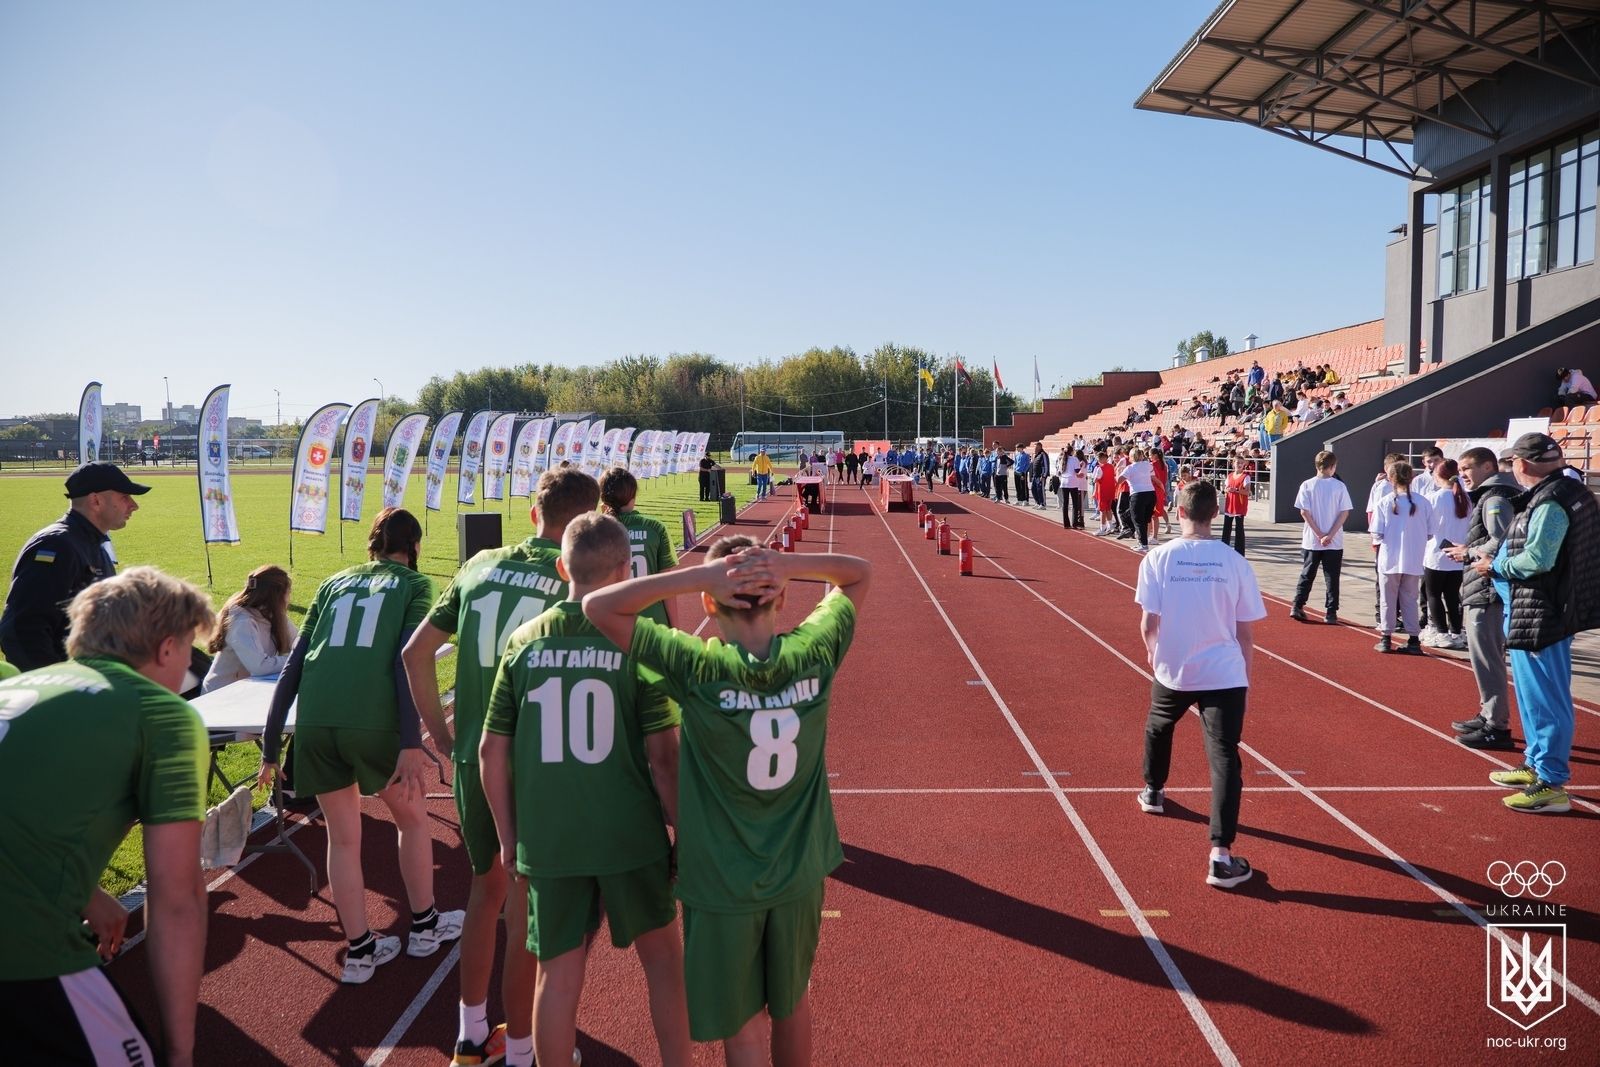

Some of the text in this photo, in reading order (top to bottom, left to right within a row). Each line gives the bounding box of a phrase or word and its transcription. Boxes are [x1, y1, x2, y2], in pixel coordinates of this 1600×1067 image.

[478, 566, 562, 595] ЗАГАЙЦІ
[630, 544, 648, 578] 5
[328, 592, 386, 648] 11
[527, 646, 623, 671] ЗАГАЙЦІ
[527, 677, 615, 764] 10
[747, 707, 800, 790] 8
